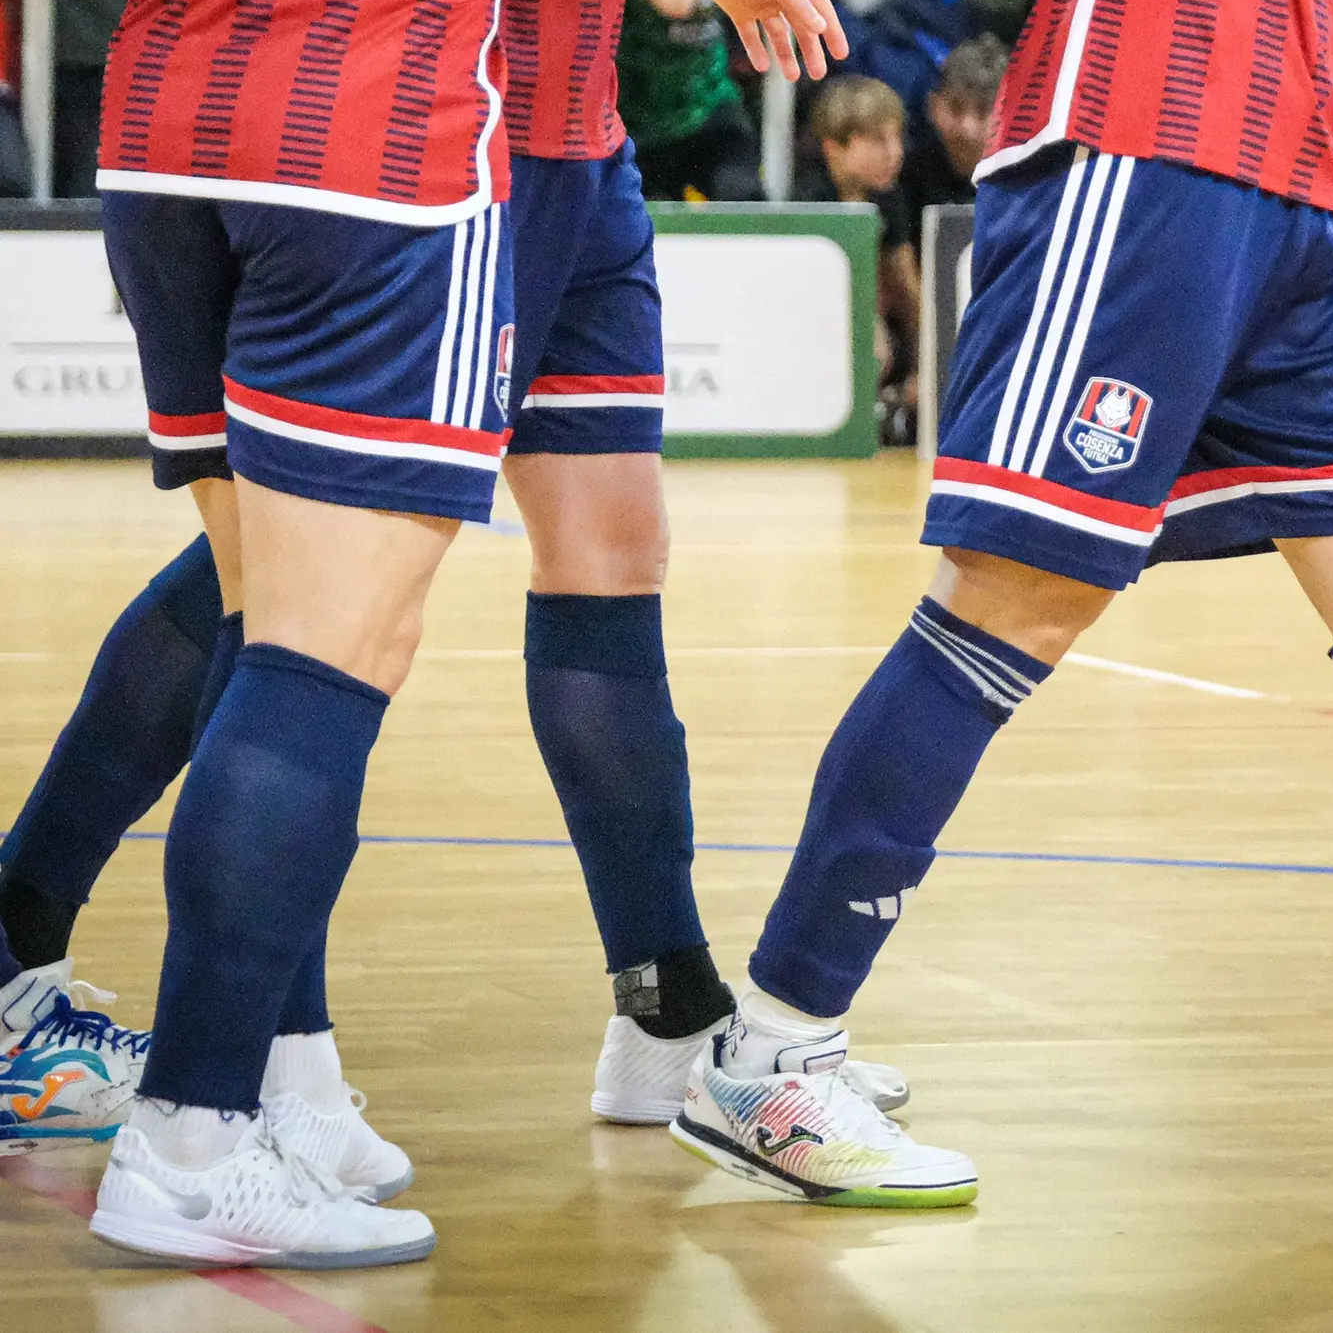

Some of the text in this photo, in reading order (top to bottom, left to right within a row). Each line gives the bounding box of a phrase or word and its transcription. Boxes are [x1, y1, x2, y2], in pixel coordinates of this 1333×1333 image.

[12, 365, 145, 398] GRU
[1075, 432, 1125, 460] COSENZA
[1083, 448, 1109, 464] FUTSAL
